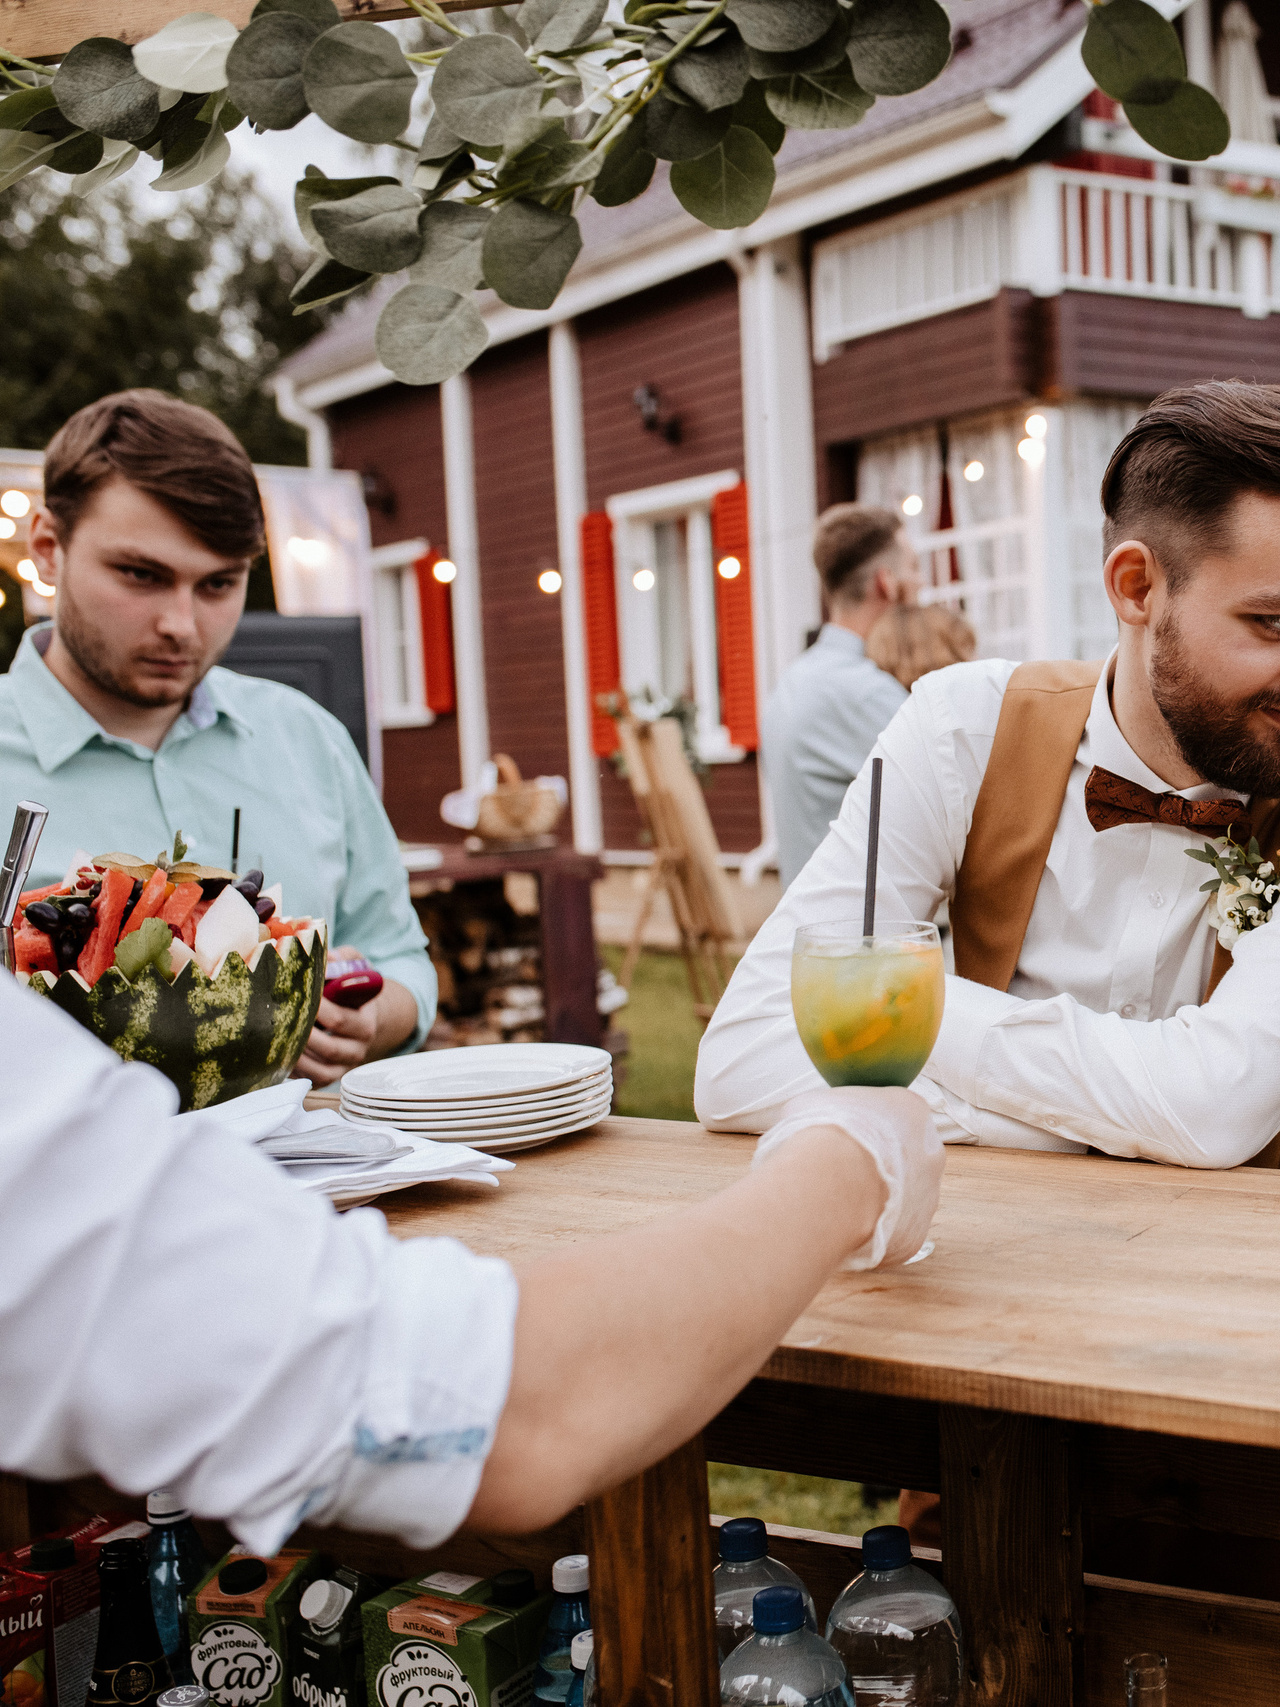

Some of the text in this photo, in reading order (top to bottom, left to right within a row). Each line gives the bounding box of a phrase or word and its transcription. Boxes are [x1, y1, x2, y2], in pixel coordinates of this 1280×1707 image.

[403, 1621, 446, 1639] АПЕЛЬСИН
[198, 1639, 258, 1661] фруктовый
[203, 1653, 265, 1690] Сад
[390, 1666, 454, 1688] фруктовый
